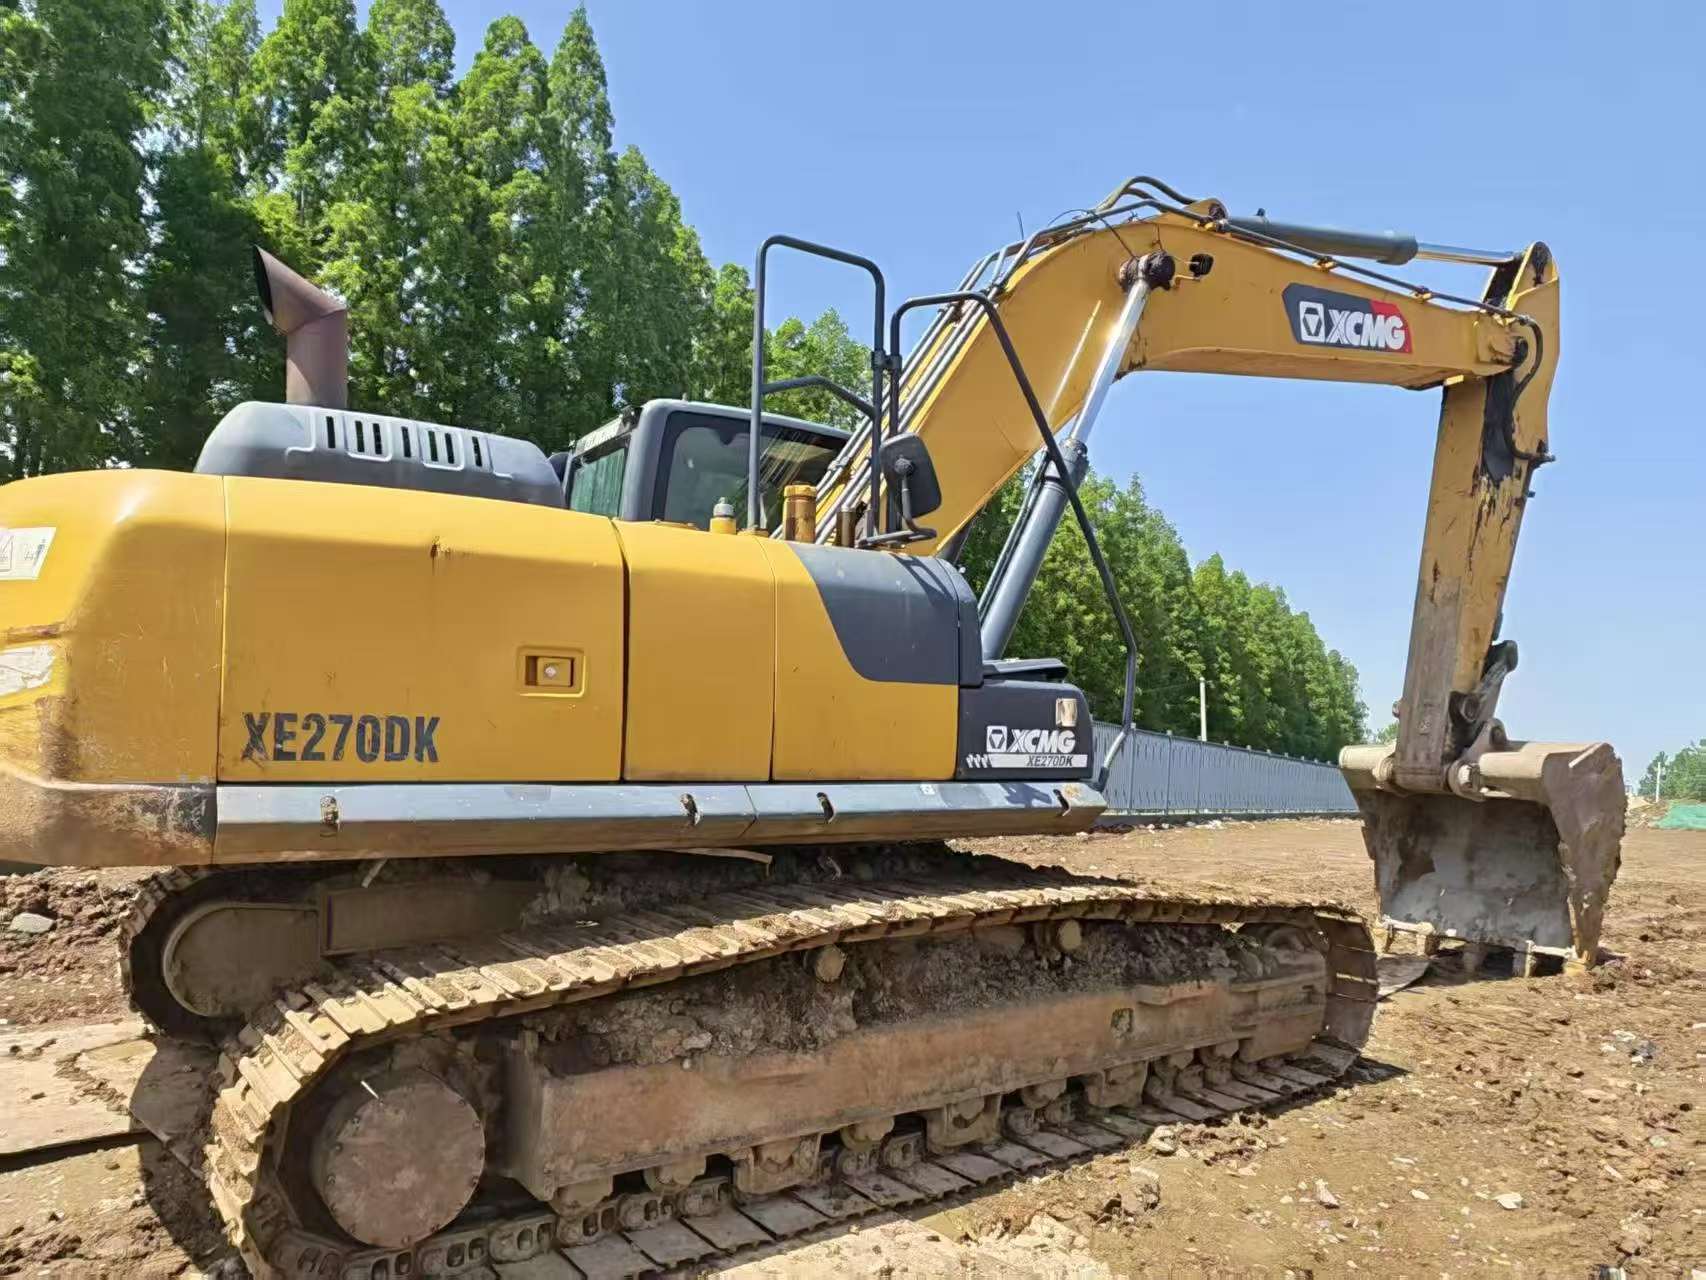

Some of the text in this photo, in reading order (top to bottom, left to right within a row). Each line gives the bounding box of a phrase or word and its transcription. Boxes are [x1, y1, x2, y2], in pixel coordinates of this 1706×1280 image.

[1326, 309, 1406, 350] XCMG
[241, 712, 440, 763] XE270DK
[1008, 729, 1076, 753] XCMG
[1026, 755, 1074, 767] XE270DK
